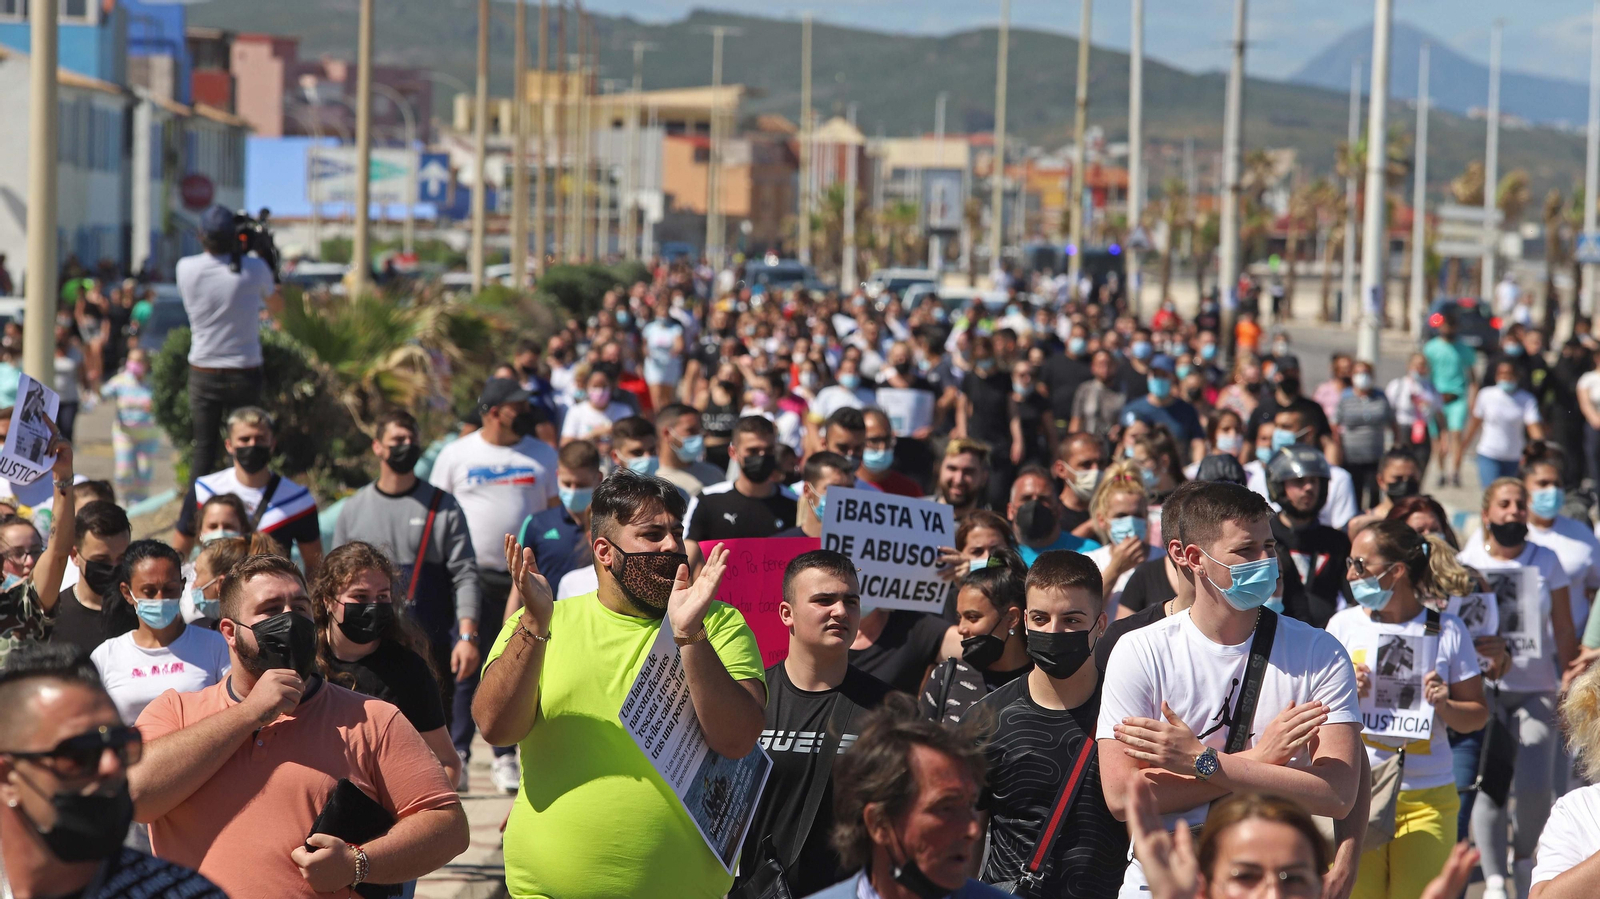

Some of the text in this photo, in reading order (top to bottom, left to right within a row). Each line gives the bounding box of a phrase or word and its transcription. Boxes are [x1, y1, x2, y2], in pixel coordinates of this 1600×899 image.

[836, 499, 945, 534] ¡BASTA YA
[825, 533, 855, 557] DE
[860, 575, 946, 604] ICIALES!
[621, 653, 658, 719] Una lancha de
[629, 653, 670, 730] narcotraficantes
[657, 694, 663, 703] a
[661, 675, 672, 695] tres
[644, 718, 664, 750] civiles
[675, 677, 682, 692] al
[651, 685, 691, 760] tras una persecu
[1362, 712, 1430, 733] JUSTICIA
